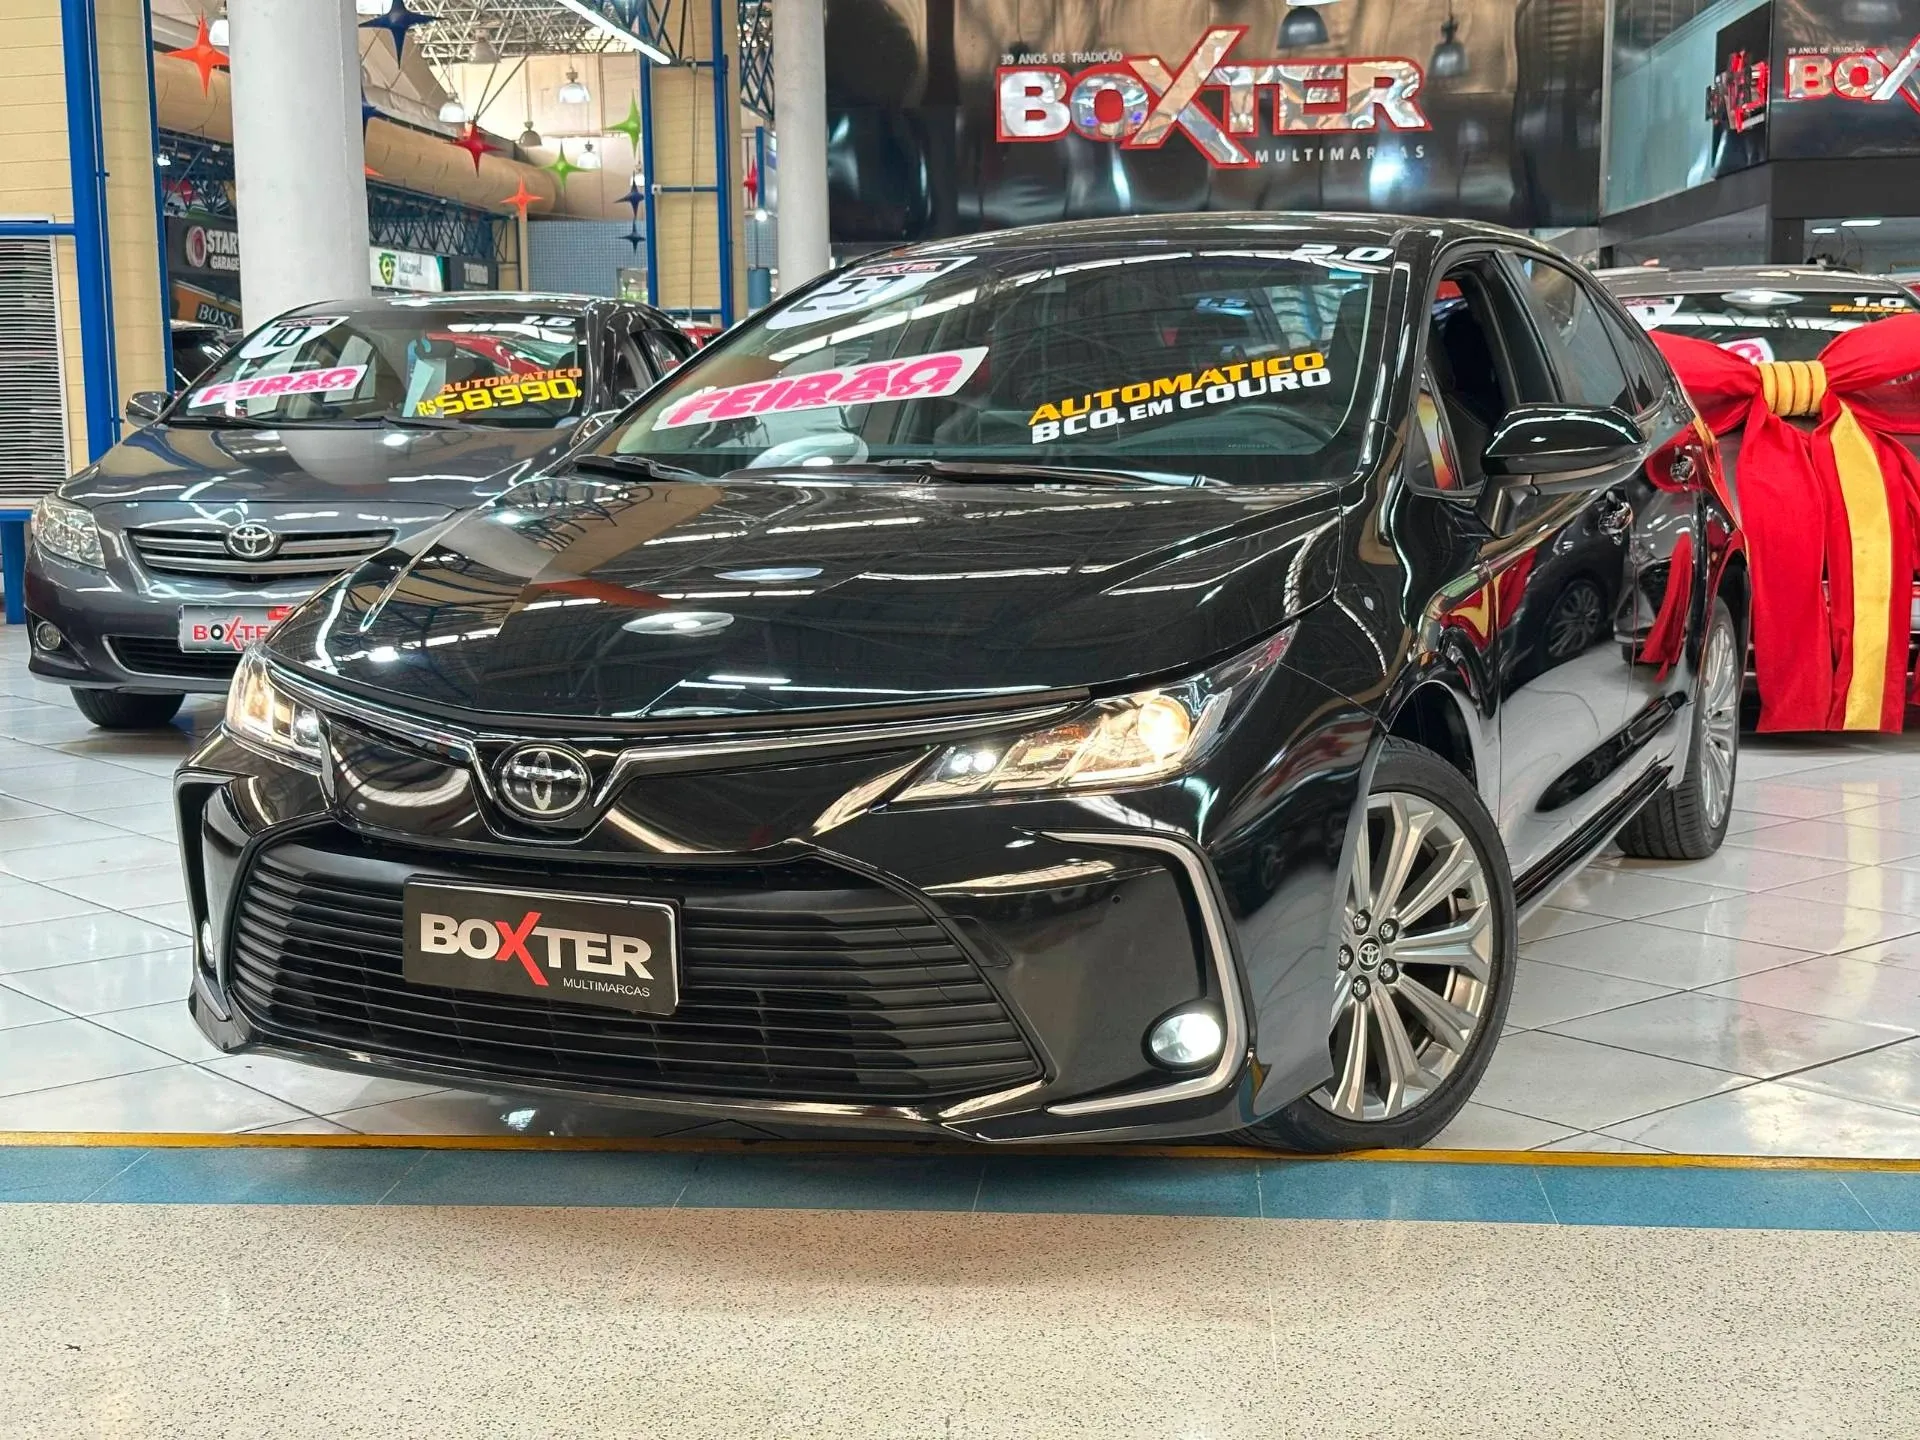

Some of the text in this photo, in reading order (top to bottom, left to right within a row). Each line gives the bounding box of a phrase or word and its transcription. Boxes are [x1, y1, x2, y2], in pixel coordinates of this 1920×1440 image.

[1001, 50, 1123, 65] 39 ANOS DE TRADIÇÃO
[997, 25, 1433, 169] BOXTER
[1255, 145, 1425, 163] MULTIMARAS
[1291, 244, 1394, 261] 2.0
[199, 303, 235, 329] BOSS
[263, 327, 312, 347] 10
[1130, 397, 1173, 422] EM
[1179, 367, 1332, 410] COURO
[193, 616, 273, 650] BOXTE
[420, 911, 655, 987] BOXTER
[562, 976, 651, 998] MULTIMARCAS
